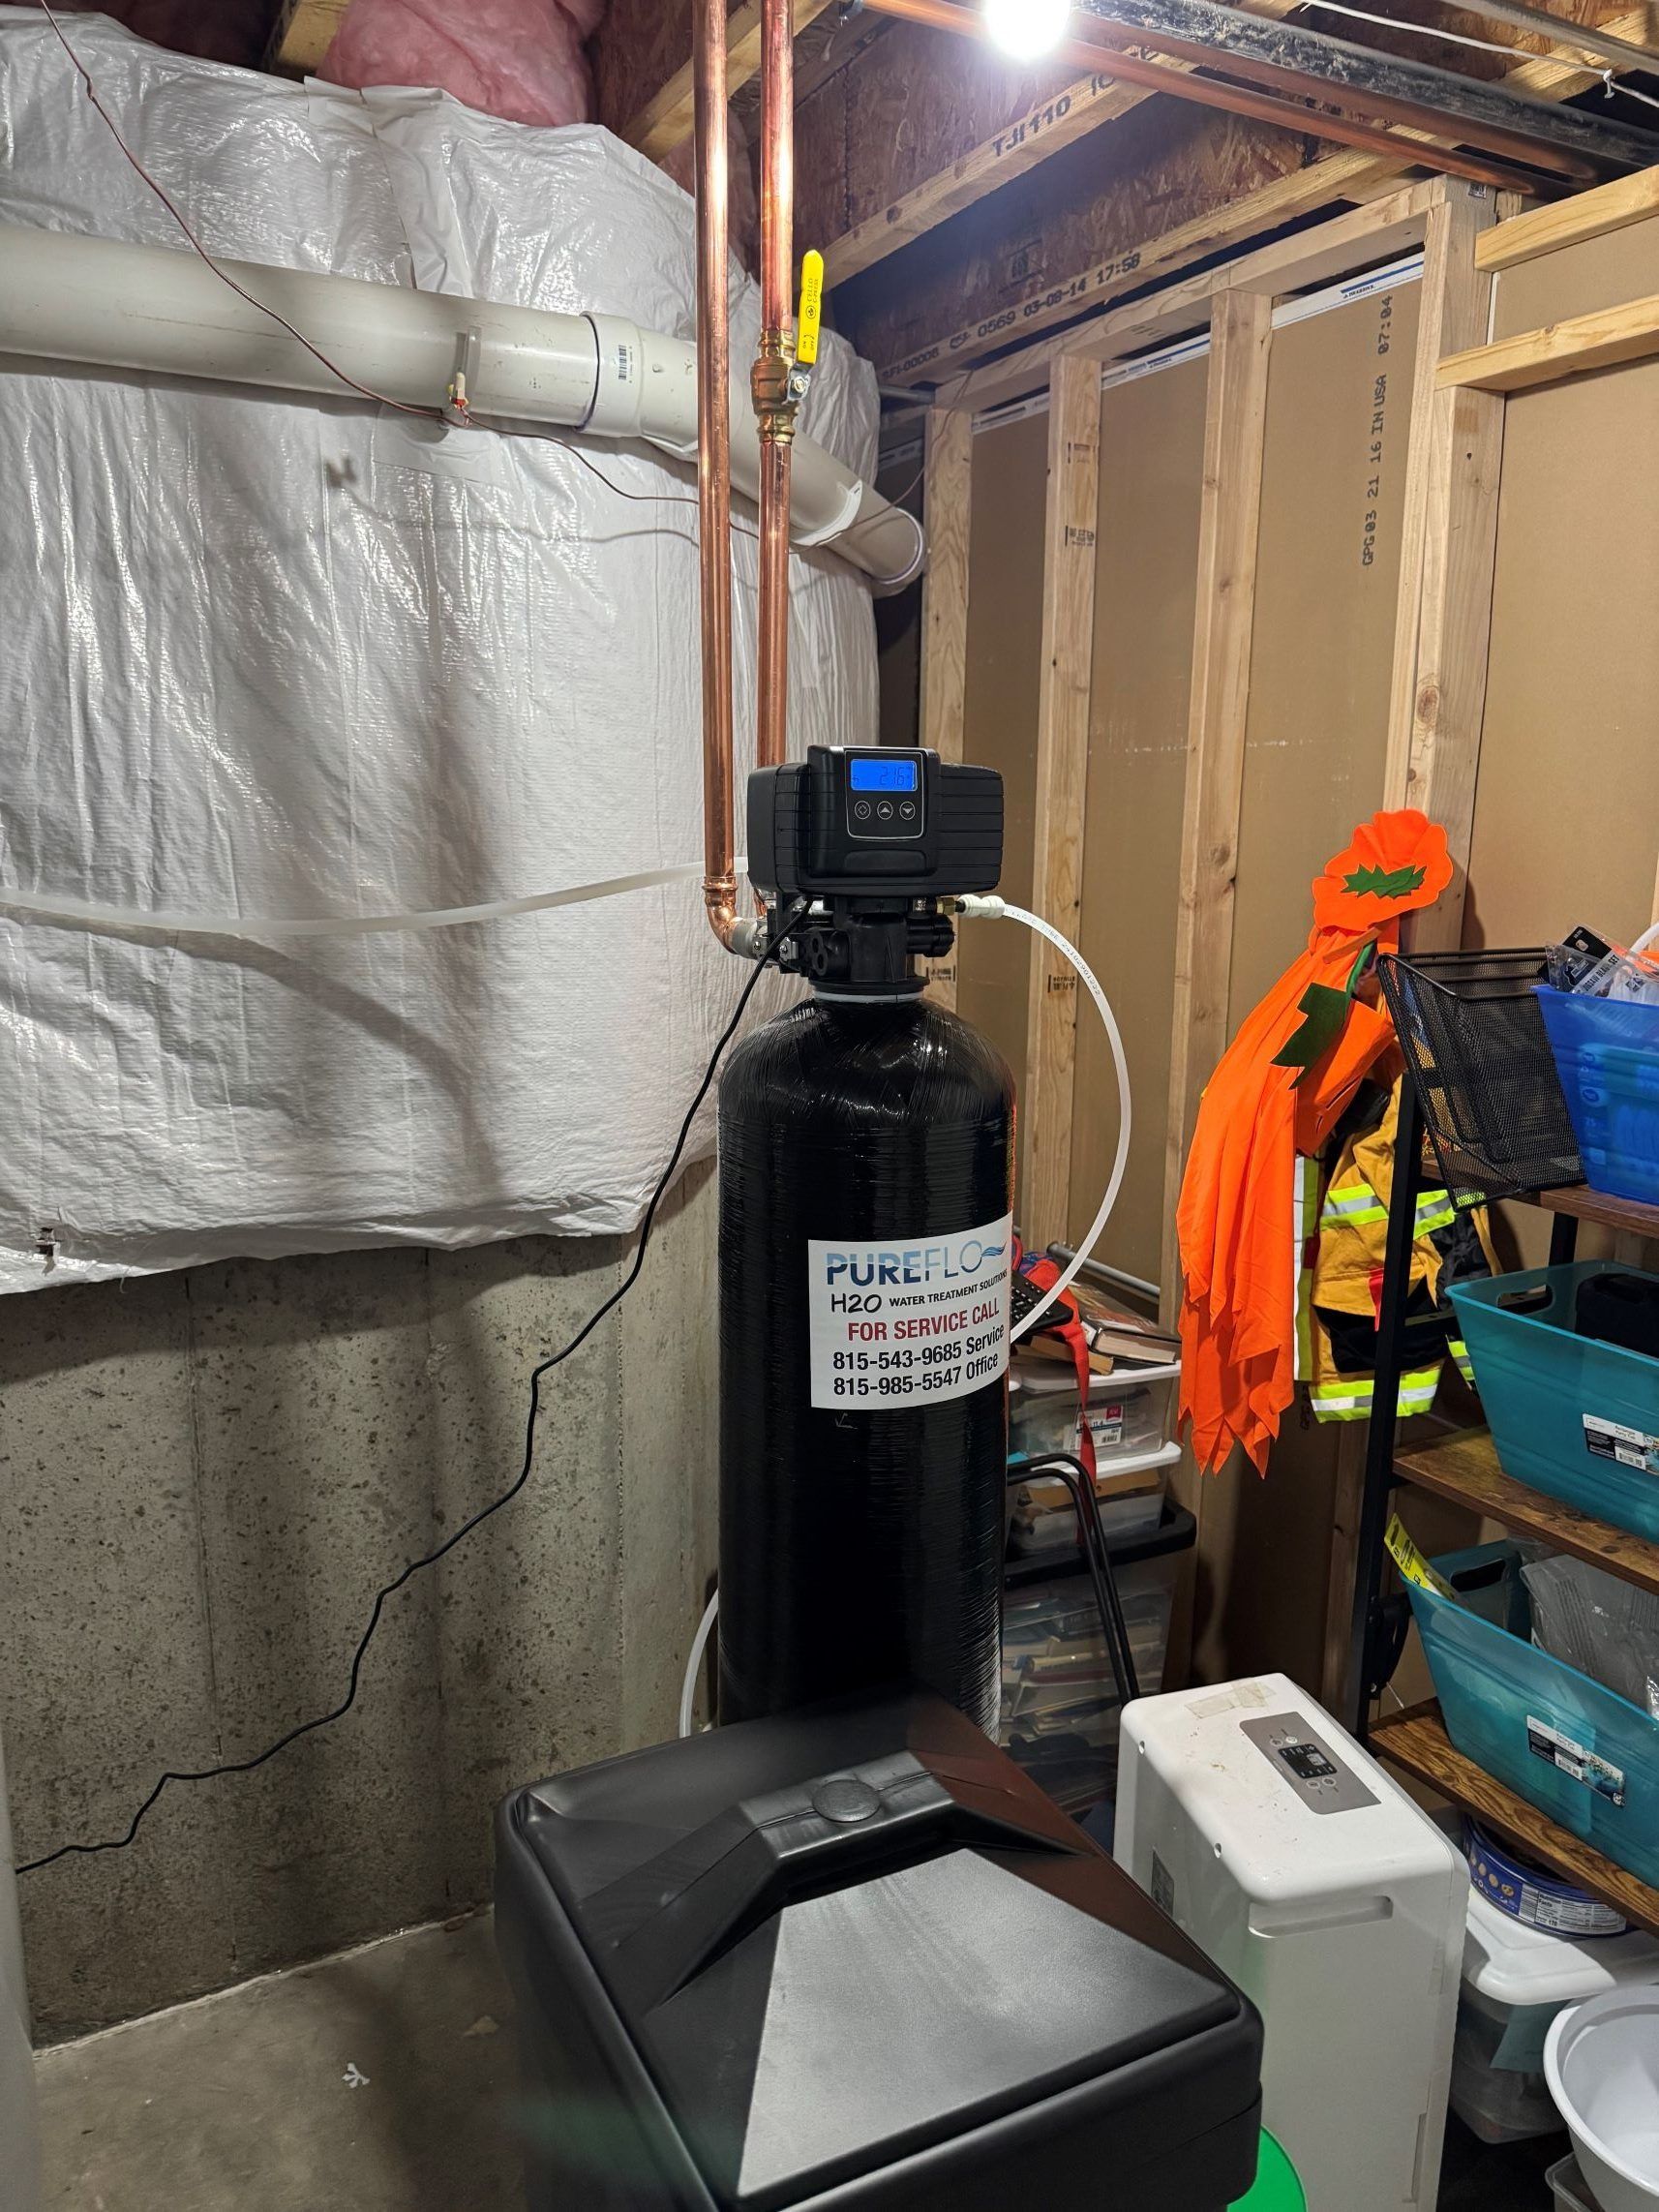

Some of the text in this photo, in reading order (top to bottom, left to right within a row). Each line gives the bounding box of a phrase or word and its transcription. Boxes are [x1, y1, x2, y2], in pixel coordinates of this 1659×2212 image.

[1377, 294, 1393, 355] 07:04
[1373, 374, 1387, 408] USA
[1372, 410, 1384, 435] IN
[1370, 439, 1382, 464] 16
[1368, 474, 1380, 499] 21
[1608, 954, 1620, 965] SET
[827, 1240, 982, 1287] PUREFLO
[830, 1268, 1008, 1314] H2O WATER TREATMENT SOLUTIONS
[848, 1297, 1000, 1342] FOR SERVICE CALL
[832, 1323, 1005, 1371] 815-543-9685 Service
[833, 1352, 999, 1396] 815-985-5547 Office
